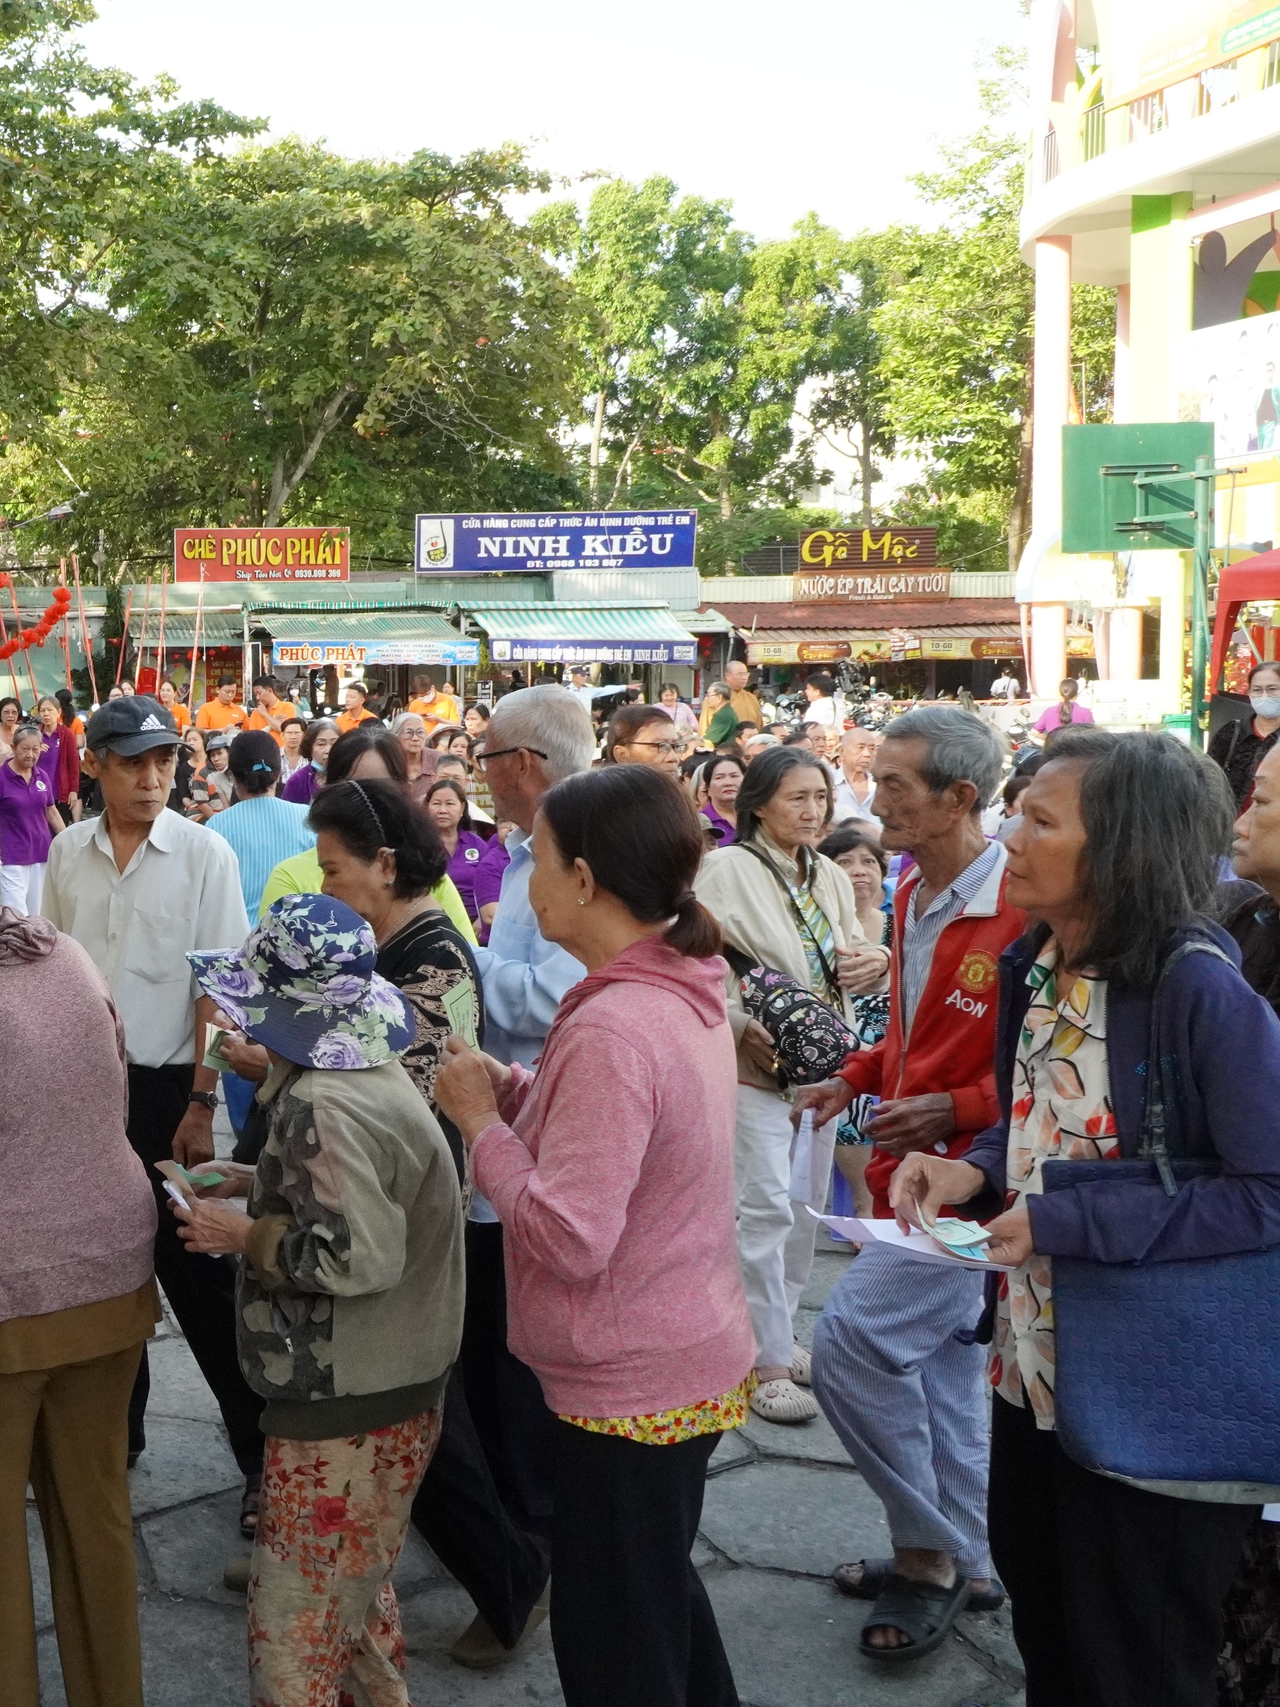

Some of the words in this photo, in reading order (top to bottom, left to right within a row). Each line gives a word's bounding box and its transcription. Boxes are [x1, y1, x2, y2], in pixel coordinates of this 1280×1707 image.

[462, 517, 481, 529] CỬA
[483, 518, 509, 528] HÀNG
[510, 518, 536, 528] CUNG
[538, 515, 557, 528] CẤP
[559, 516, 583, 527] THỨC
[584, 515, 598, 527] ĂN
[675, 515, 690, 525] EM
[183, 533, 216, 559] CHÈ
[222, 530, 282, 566] PHÚC
[286, 530, 345, 566] PHÁT
[477, 536, 570, 557] NINH
[581, 527, 674, 556] KIỀU
[801, 530, 851, 567] Gỗ
[862, 529, 918, 564] Mộc
[579, 559, 599, 568] 193
[799, 574, 834, 595] NƯỚC
[836, 574, 853, 595] ÉP
[856, 574, 886, 594] TRÁI
[888, 573, 914, 593] CÂY
[916, 572, 946, 592] TƯƠI
[278, 643, 322, 661] PHÚC
[325, 643, 367, 661] PHÁT
[945, 989, 988, 1018] AON
